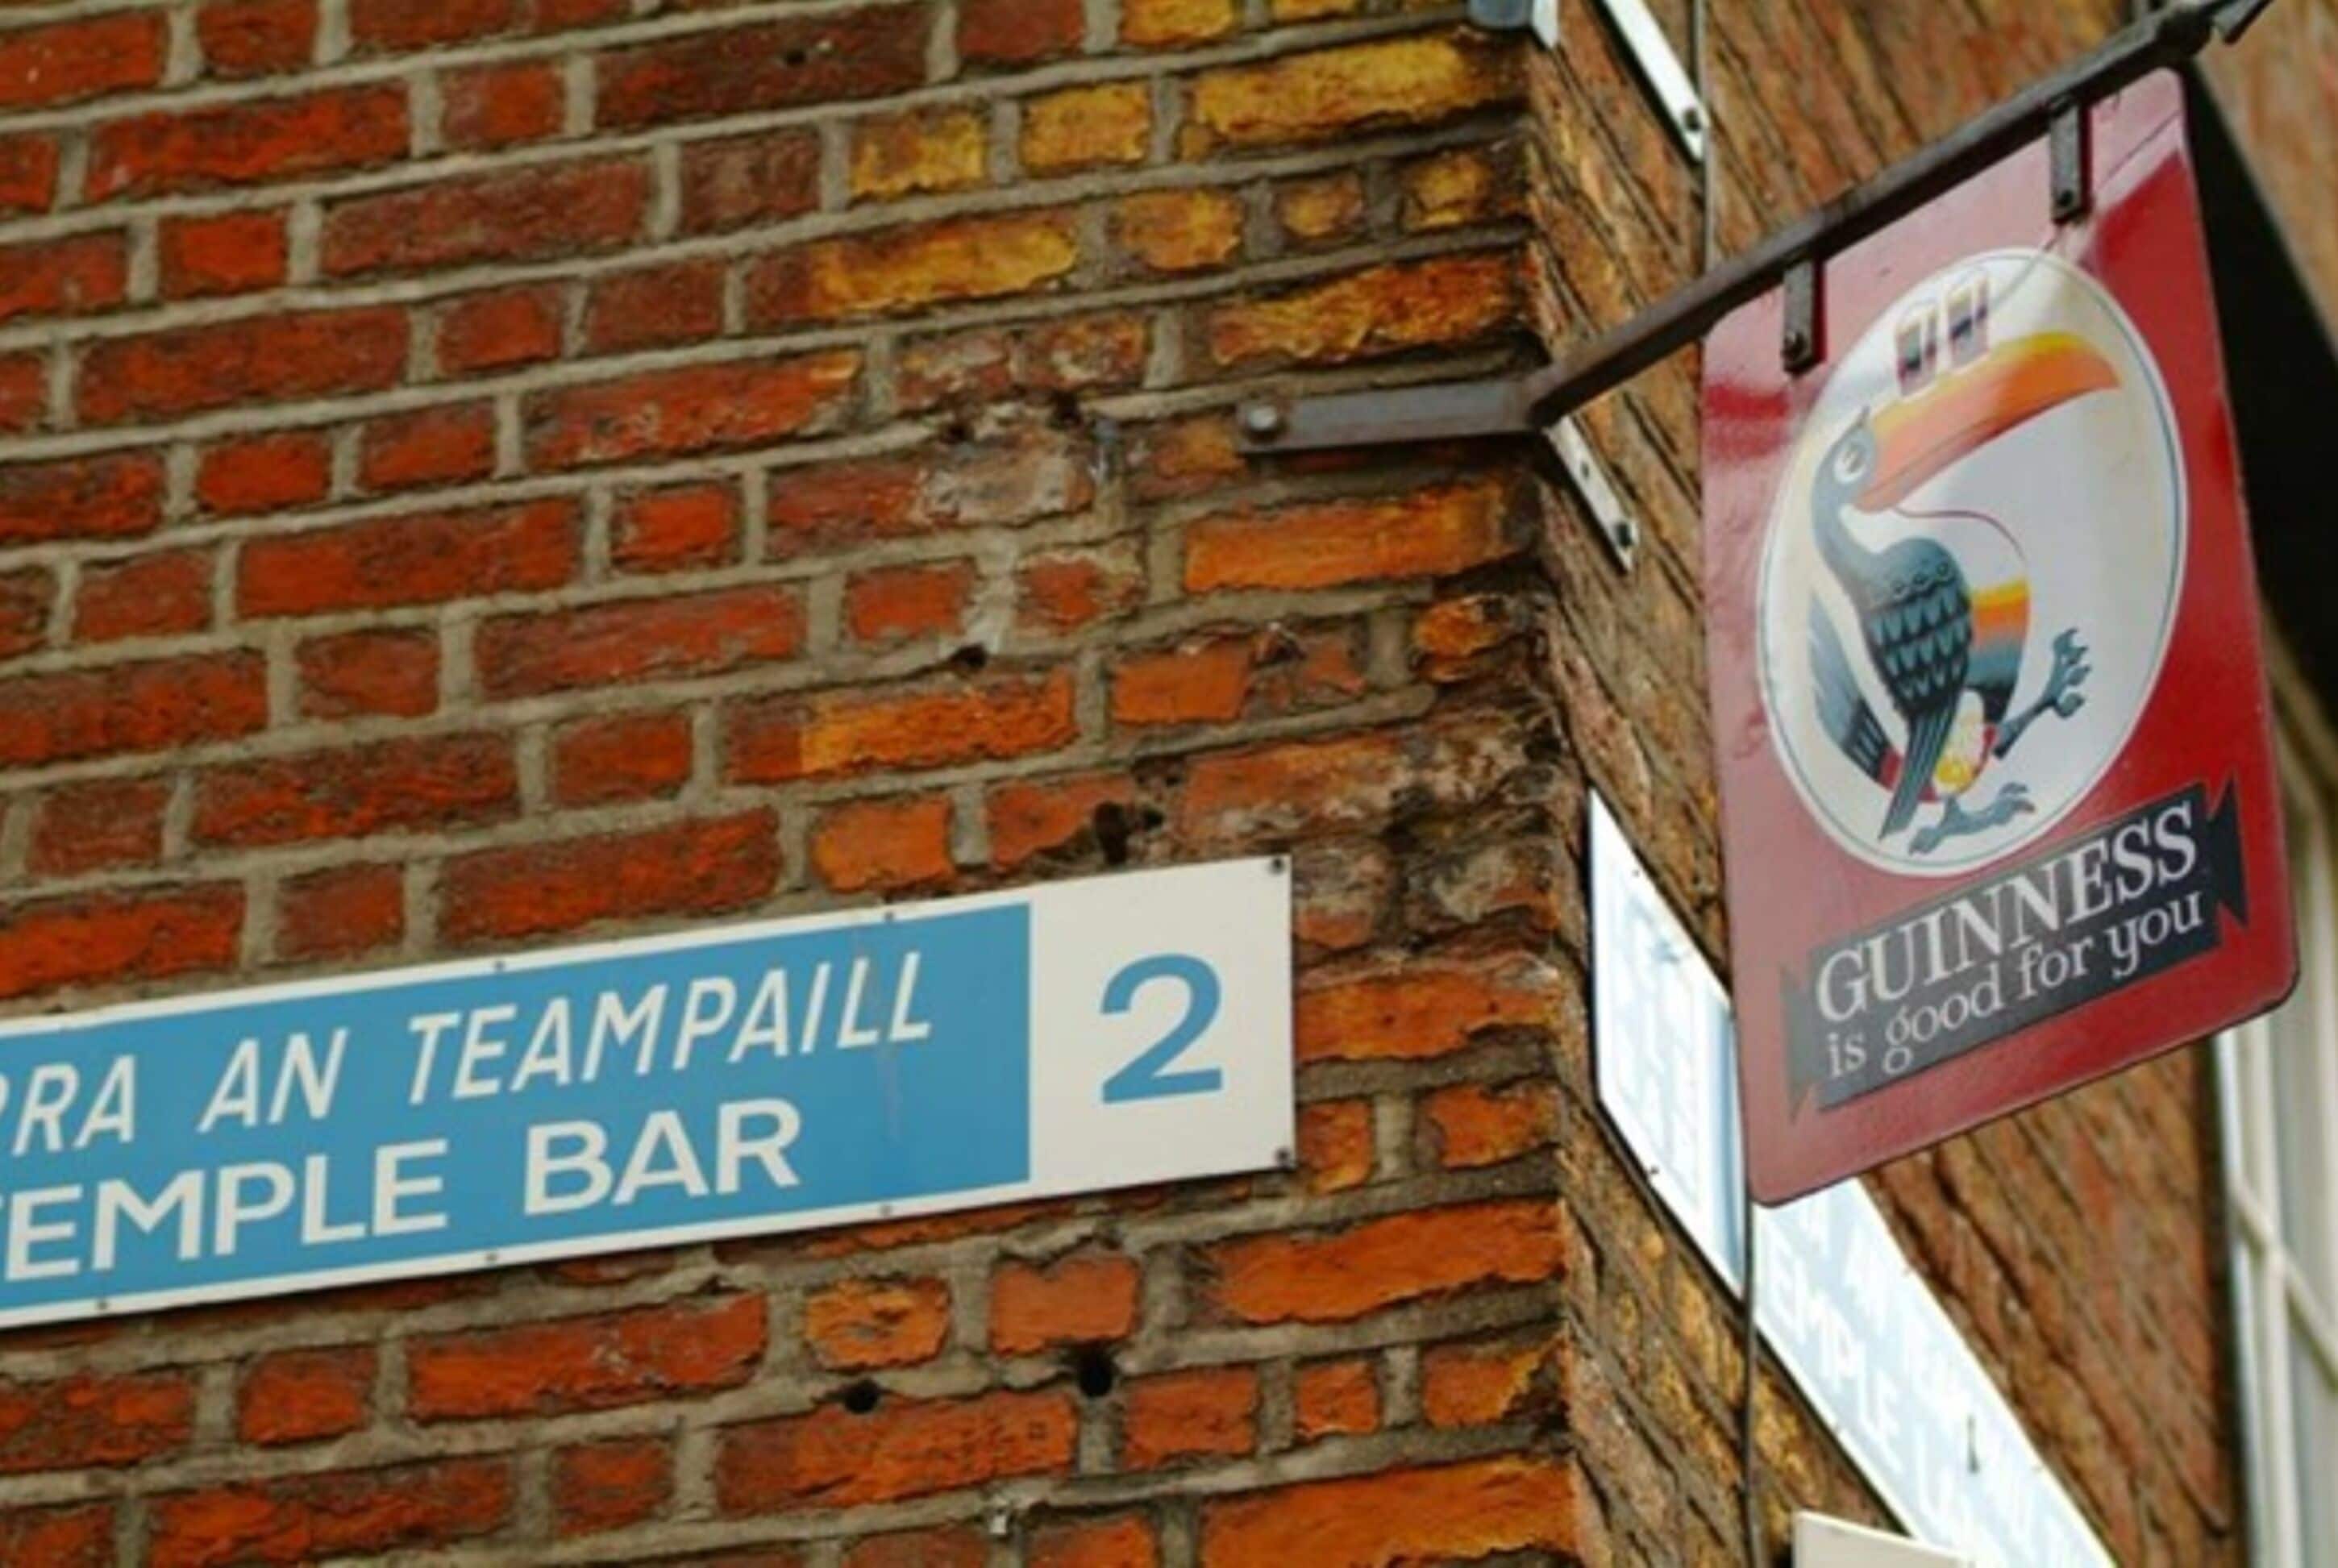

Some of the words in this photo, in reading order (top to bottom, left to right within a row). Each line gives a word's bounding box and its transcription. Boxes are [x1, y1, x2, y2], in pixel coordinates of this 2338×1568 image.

[1817, 801, 2197, 1022] GUINNESS
[1827, 1026, 1866, 1077] is
[1882, 963, 2003, 1075] good
[2016, 937, 2094, 1001] for
[2104, 892, 2205, 979] you
[197, 1027, 349, 1132] AN
[409, 951, 932, 1105] TEAMPAILL
[1100, 954, 1222, 1104] 2
[0, 1138, 449, 1282] EMPLE
[524, 1097, 801, 1216] BAR
